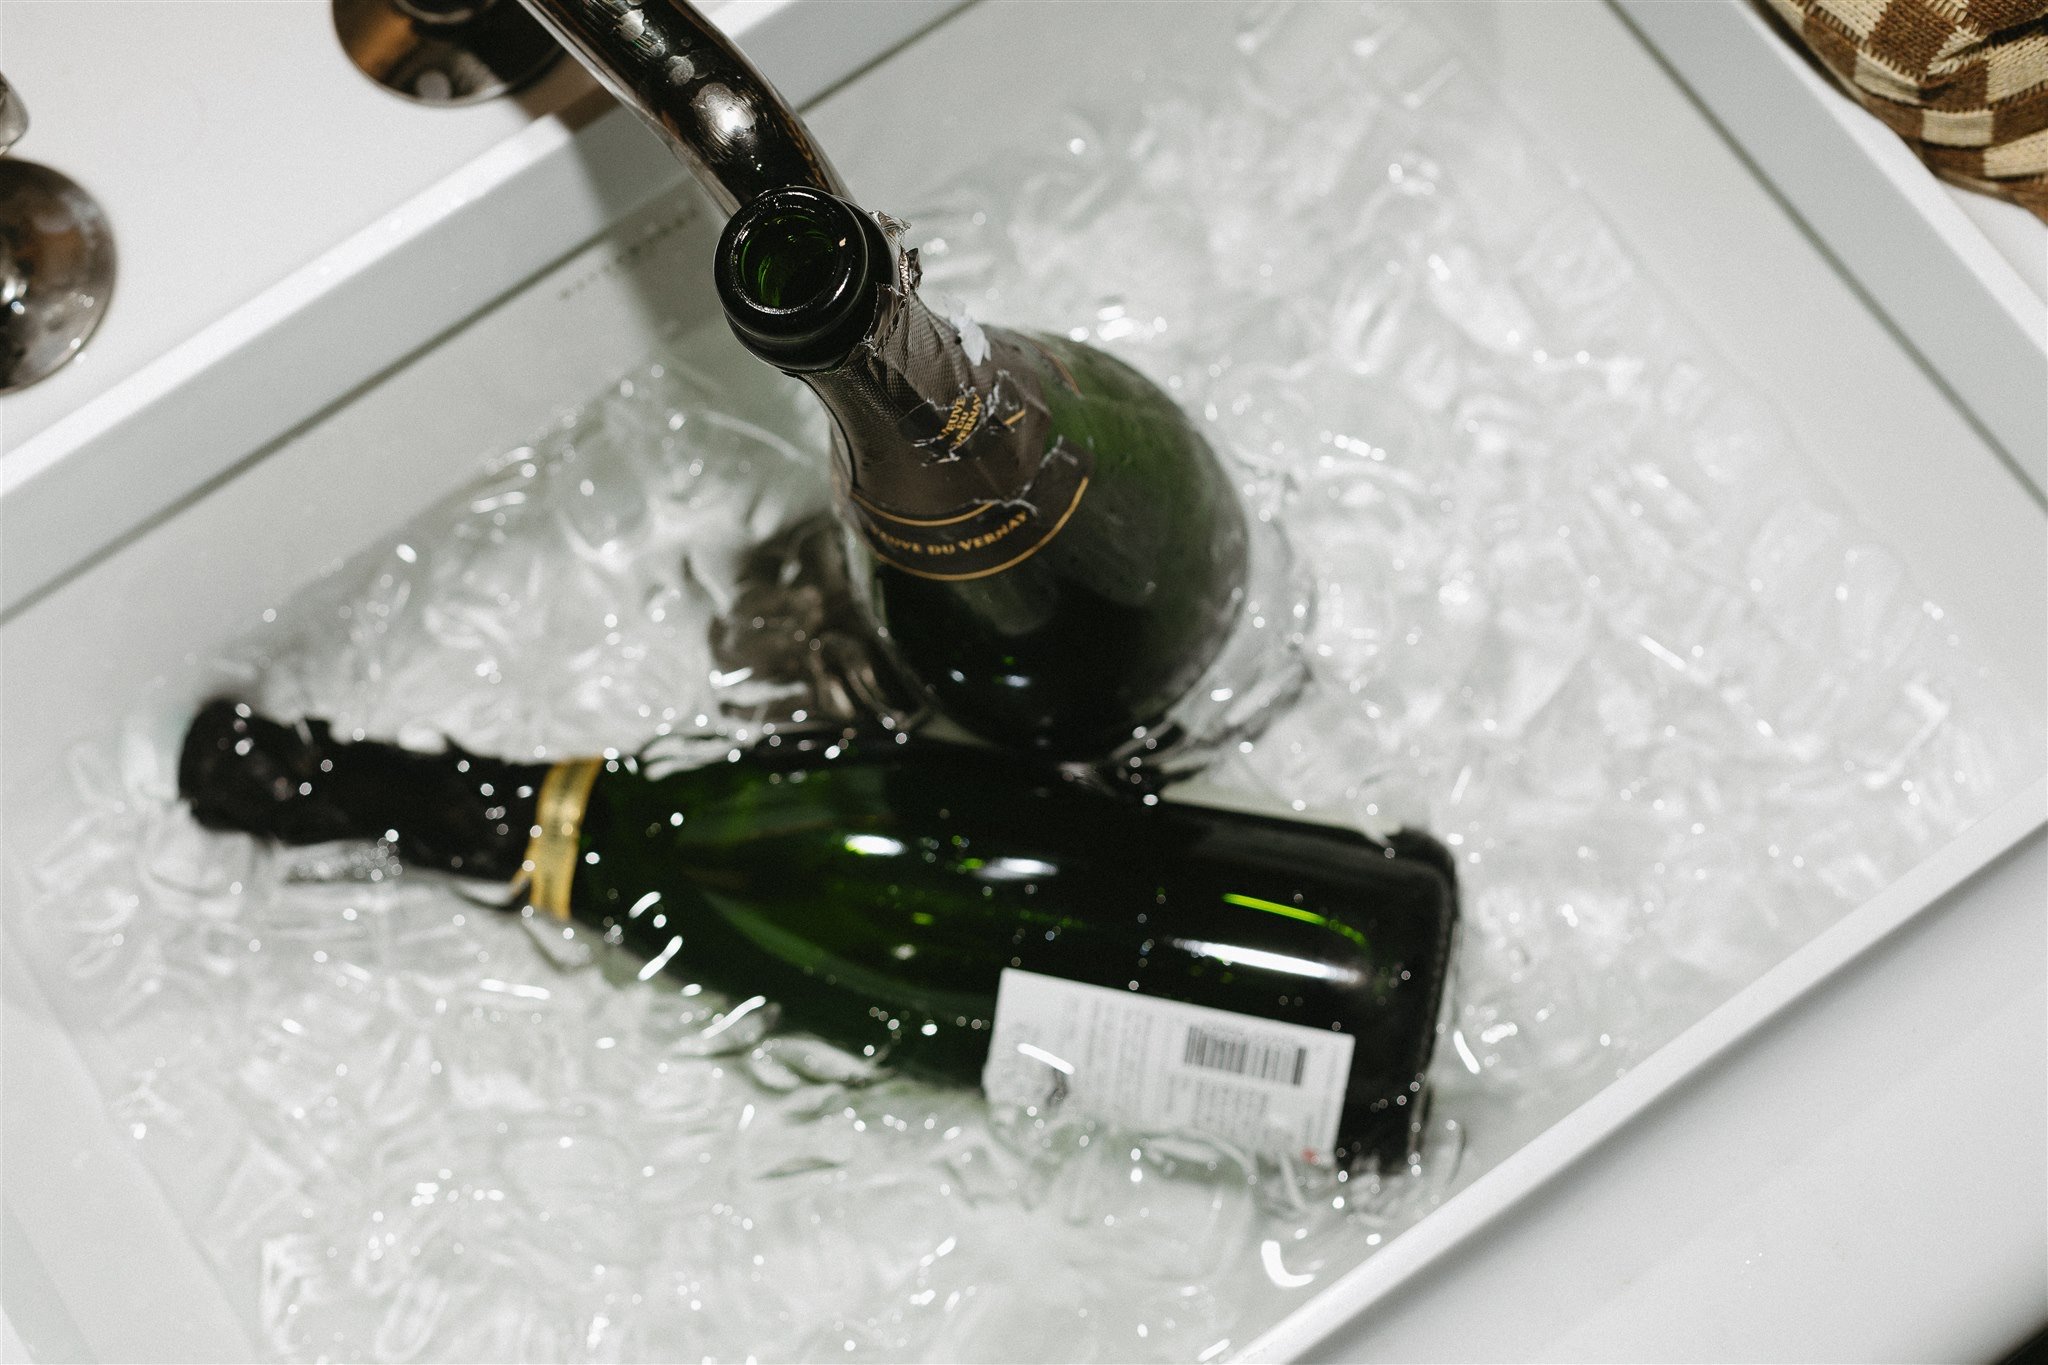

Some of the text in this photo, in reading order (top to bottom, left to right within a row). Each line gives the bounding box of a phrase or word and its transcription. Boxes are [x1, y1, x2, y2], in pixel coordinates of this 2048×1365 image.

[951, 393, 981, 447] VERNAY
[955, 411, 969, 429] DU
[926, 543, 956, 556] DU
[958, 511, 1027, 551] VERNAY
